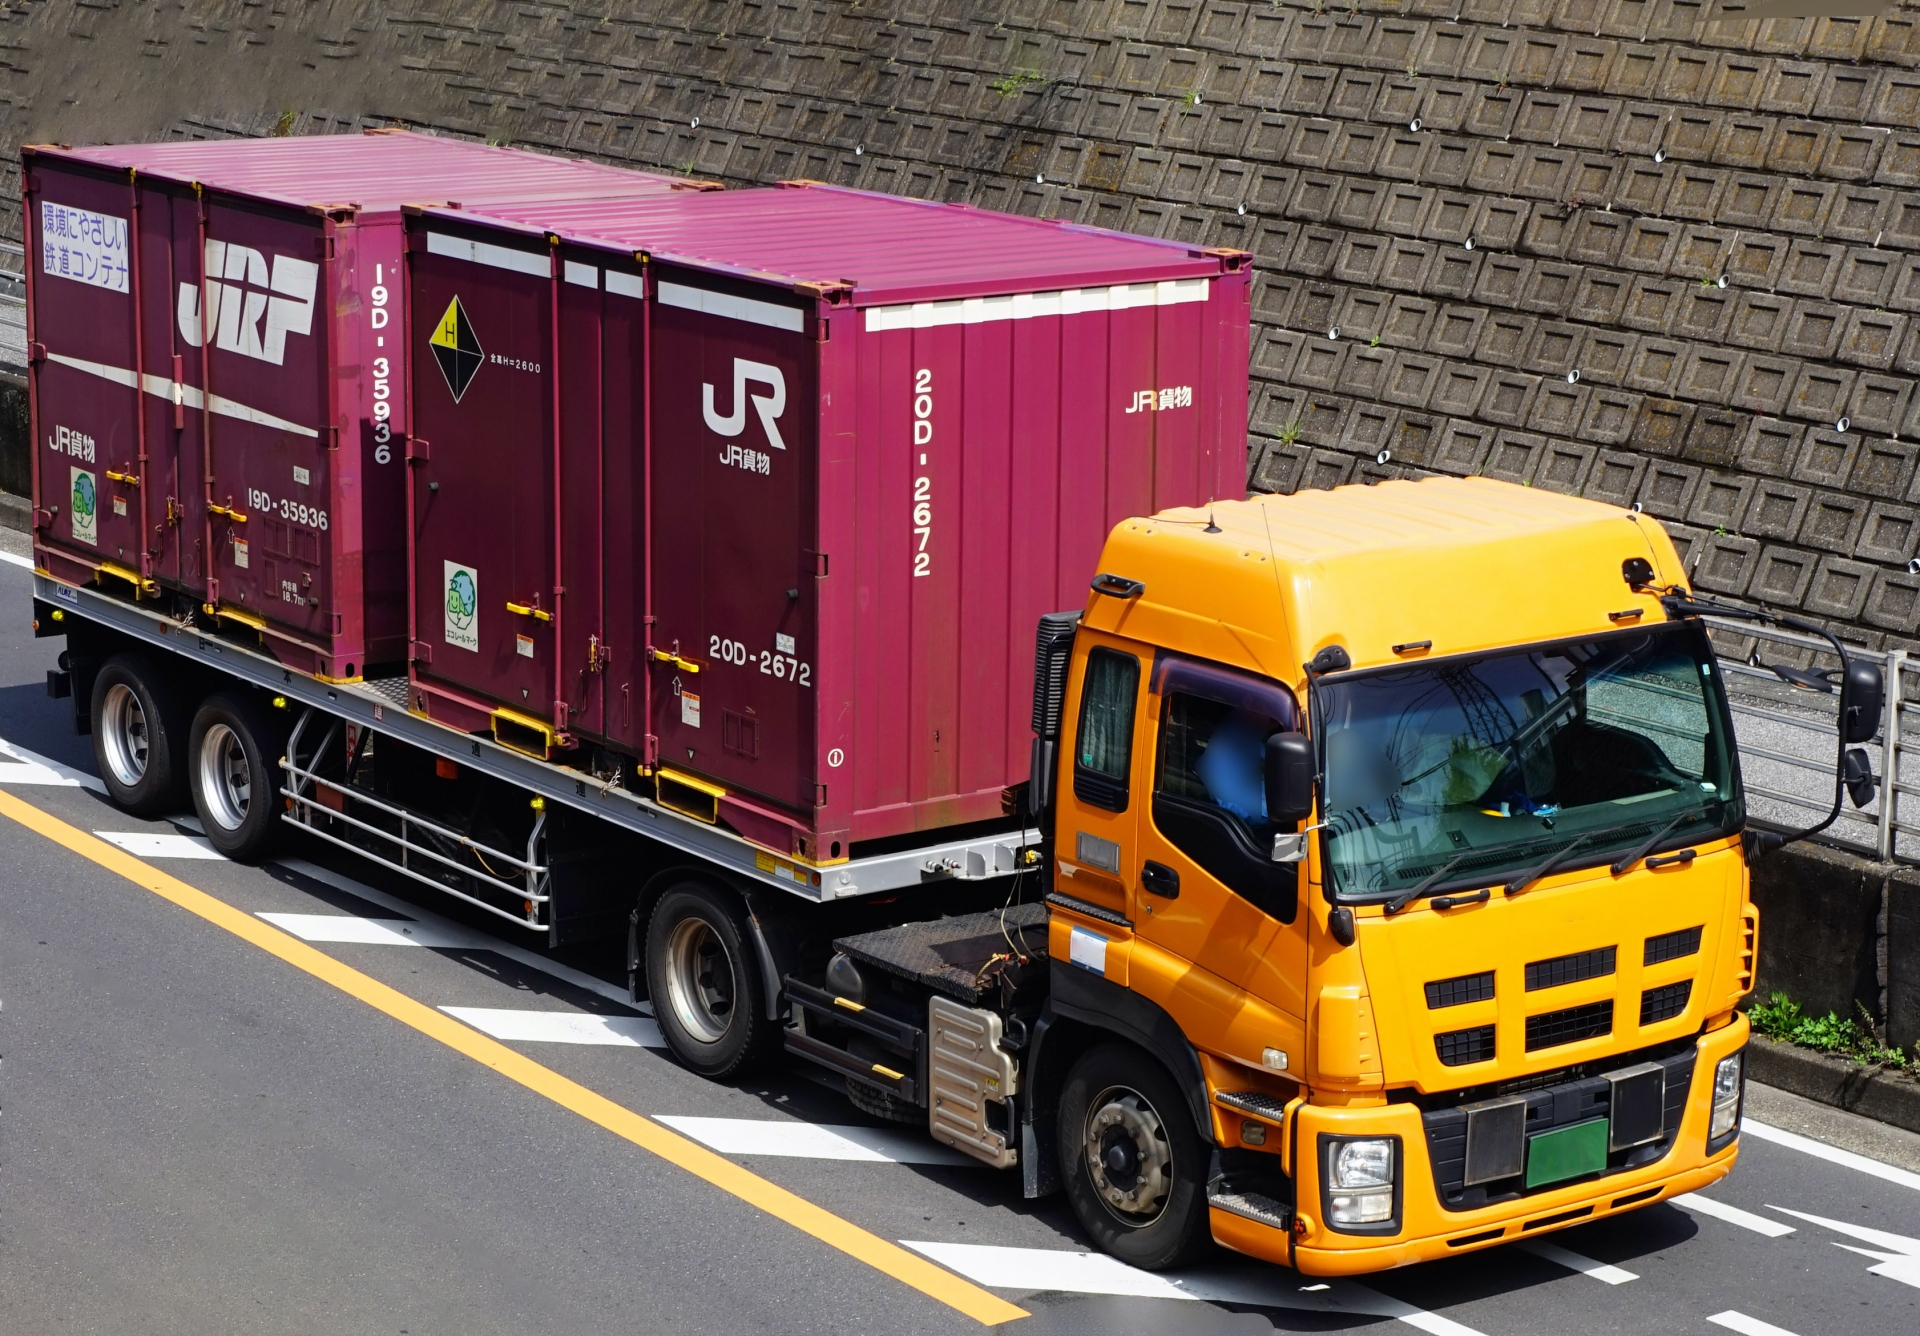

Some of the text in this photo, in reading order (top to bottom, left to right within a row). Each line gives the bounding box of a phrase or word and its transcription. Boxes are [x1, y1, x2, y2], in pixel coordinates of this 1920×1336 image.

[43, 203, 127, 251] 環境にやさしい
[44, 241, 128, 289] 鉄道コンテナ
[445, 320, 456, 345] H
[371, 263, 391, 465] 19D-35936
[702, 357, 787, 451] JR
[1125, 385, 1192, 414] JR貨物
[48, 424, 96, 464] JR貨物
[719, 443, 770, 476] JR貨物
[913, 368, 933, 578] 20D-2672
[248, 487, 328, 531] 19D-35936
[446, 629, 477, 646] エコレールマーク
[709, 634, 811, 688] 20D-2672
